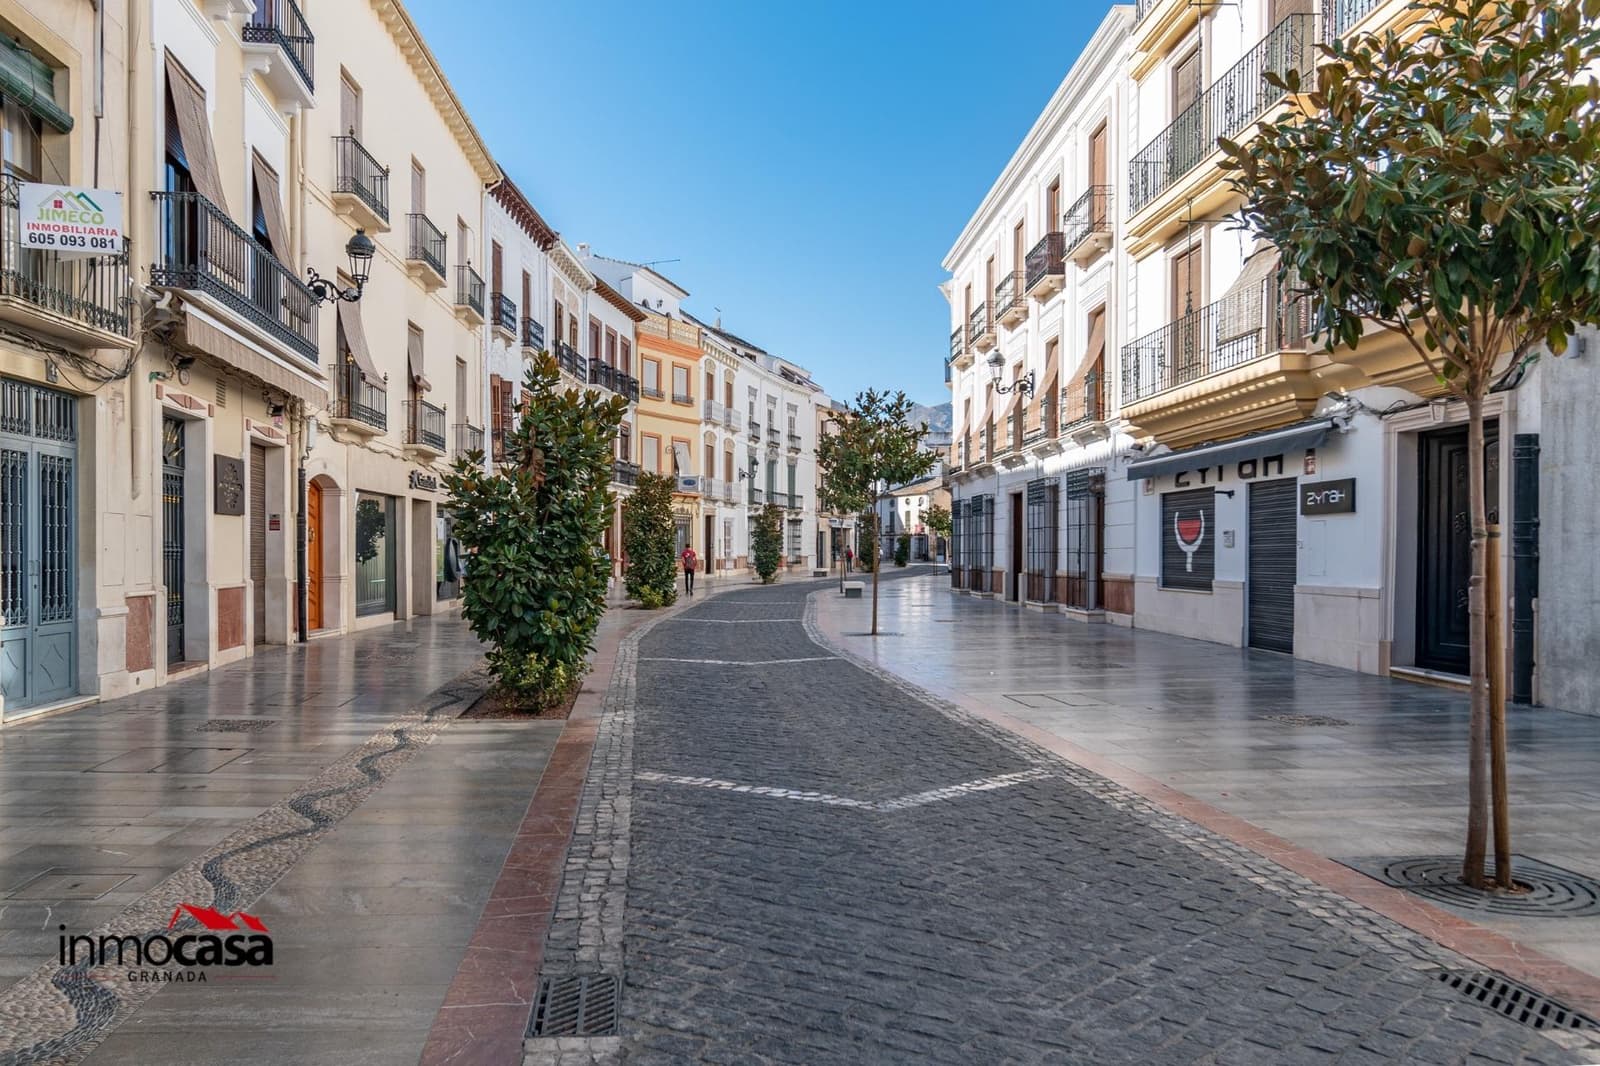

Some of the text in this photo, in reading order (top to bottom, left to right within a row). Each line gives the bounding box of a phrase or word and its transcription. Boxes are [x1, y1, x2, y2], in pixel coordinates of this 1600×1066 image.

[37, 207, 105, 225] JIMECO
[26, 222, 118, 237] INMOBILIARIA
[28, 232, 115, 250] 605 093 081
